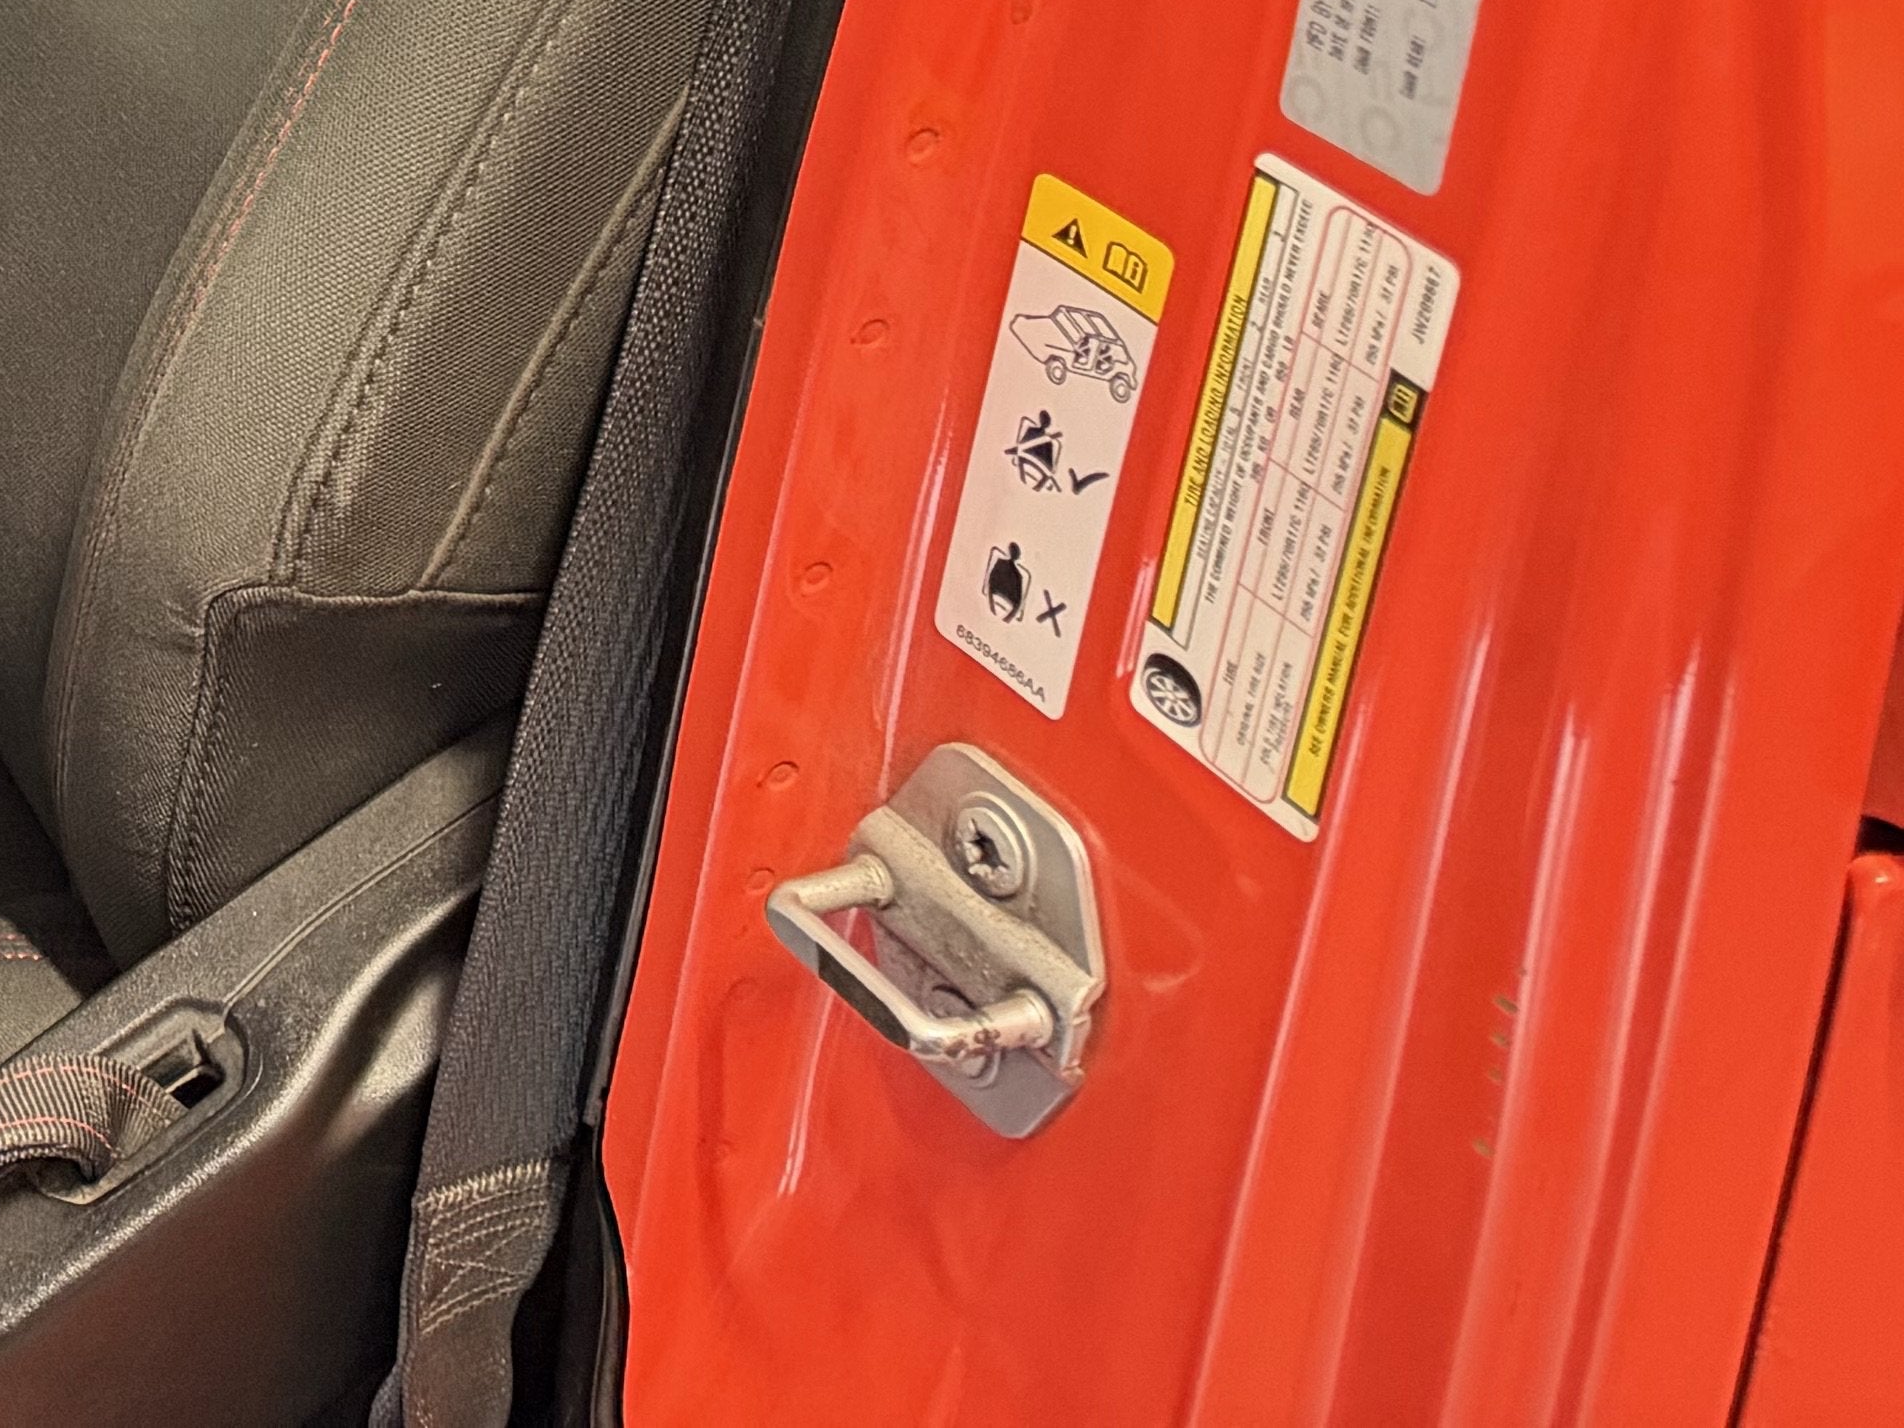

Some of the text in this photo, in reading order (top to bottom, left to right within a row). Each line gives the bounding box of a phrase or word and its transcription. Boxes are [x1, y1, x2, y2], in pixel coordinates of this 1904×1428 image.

[1184, 292, 1246, 509] TIRE AND LOADING INFORMATION
[1209, 522, 1232, 582] COMBINED
[1224, 479, 1243, 524] WEIGHT
[1238, 394, 1263, 463] OCCUPANTS
[1262, 328, 1280, 370] CARGO
[1284, 242, 1302, 283] NEVER
[1256, 506, 1275, 547] FRONT
[1288, 385, 1306, 421] REAR
